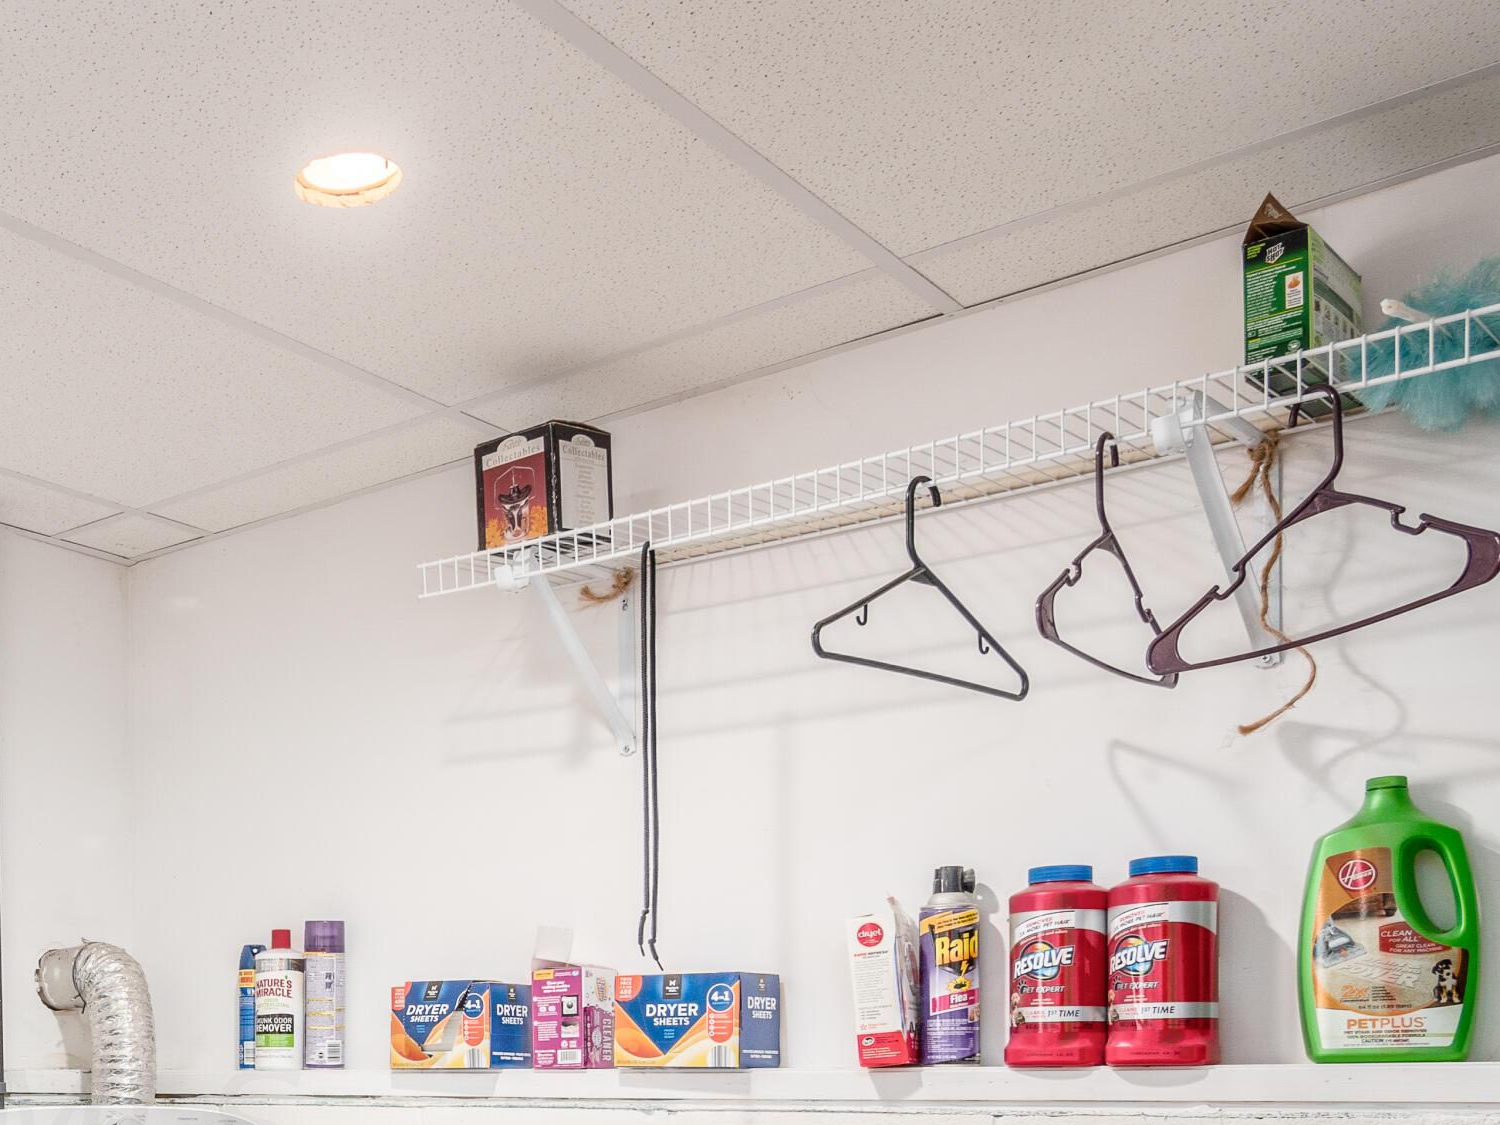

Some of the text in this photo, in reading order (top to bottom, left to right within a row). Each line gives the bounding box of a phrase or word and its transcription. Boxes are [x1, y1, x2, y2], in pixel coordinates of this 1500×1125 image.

[1380, 929, 1413, 938] CLEAN
[935, 929, 979, 967] Raid
[1014, 947, 1074, 980] RESOLVE
[1110, 940, 1168, 976] RESOLVE
[1022, 985, 1066, 994] PET EXPERT
[1129, 981, 1159, 990] EXPERT
[256, 987, 293, 999] MIRACLE
[950, 993, 968, 1004] Flea
[747, 995, 777, 1010] DRYER
[406, 1003, 449, 1016] DRYER
[496, 1003, 529, 1018] DRYER
[645, 1002, 699, 1017] DRYER
[752, 1010, 773, 1019] SHEETS
[1059, 1009, 1080, 1018] TIME
[1153, 1005, 1175, 1014] TIME
[410, 1015, 440, 1023] SHEETS
[501, 1016, 524, 1025] SHEETS
[653, 1016, 690, 1026] SHEETS
[602, 1018, 612, 1061] CLEANER
